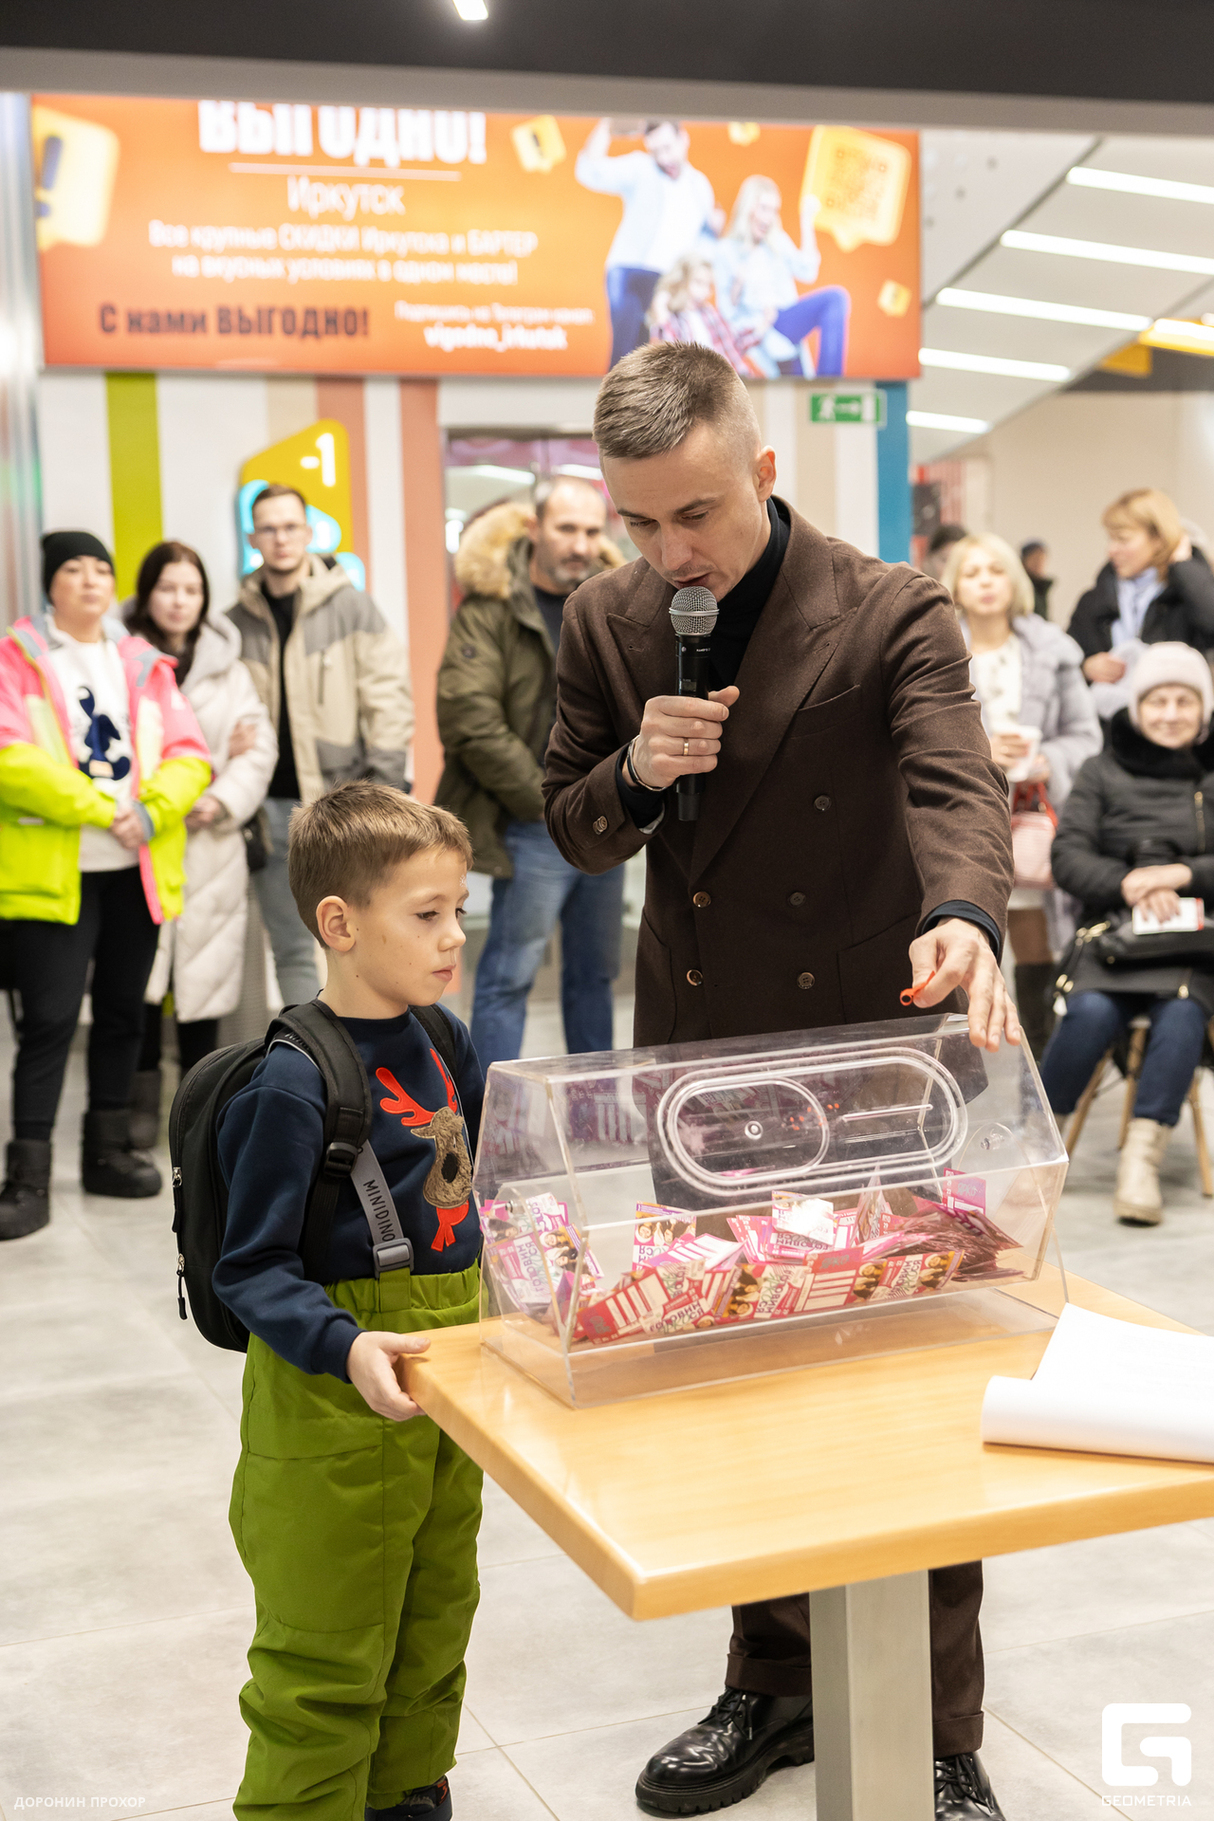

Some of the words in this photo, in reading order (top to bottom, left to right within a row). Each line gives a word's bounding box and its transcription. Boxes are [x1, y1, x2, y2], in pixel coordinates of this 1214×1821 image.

[287, 175, 406, 219] Иркутск
[149, 219, 189, 248] Все
[278, 222, 359, 254] СКИДКИ
[361, 225, 449, 258] Иркутска
[467, 229, 538, 258] БАРТЕР
[172, 254, 199, 278] на
[101, 304, 116, 333] С
[128, 311, 207, 334] нами
[217, 306, 368, 338] ВЫГОДНО!
[363, 1179, 396, 1242] MINIDINO
